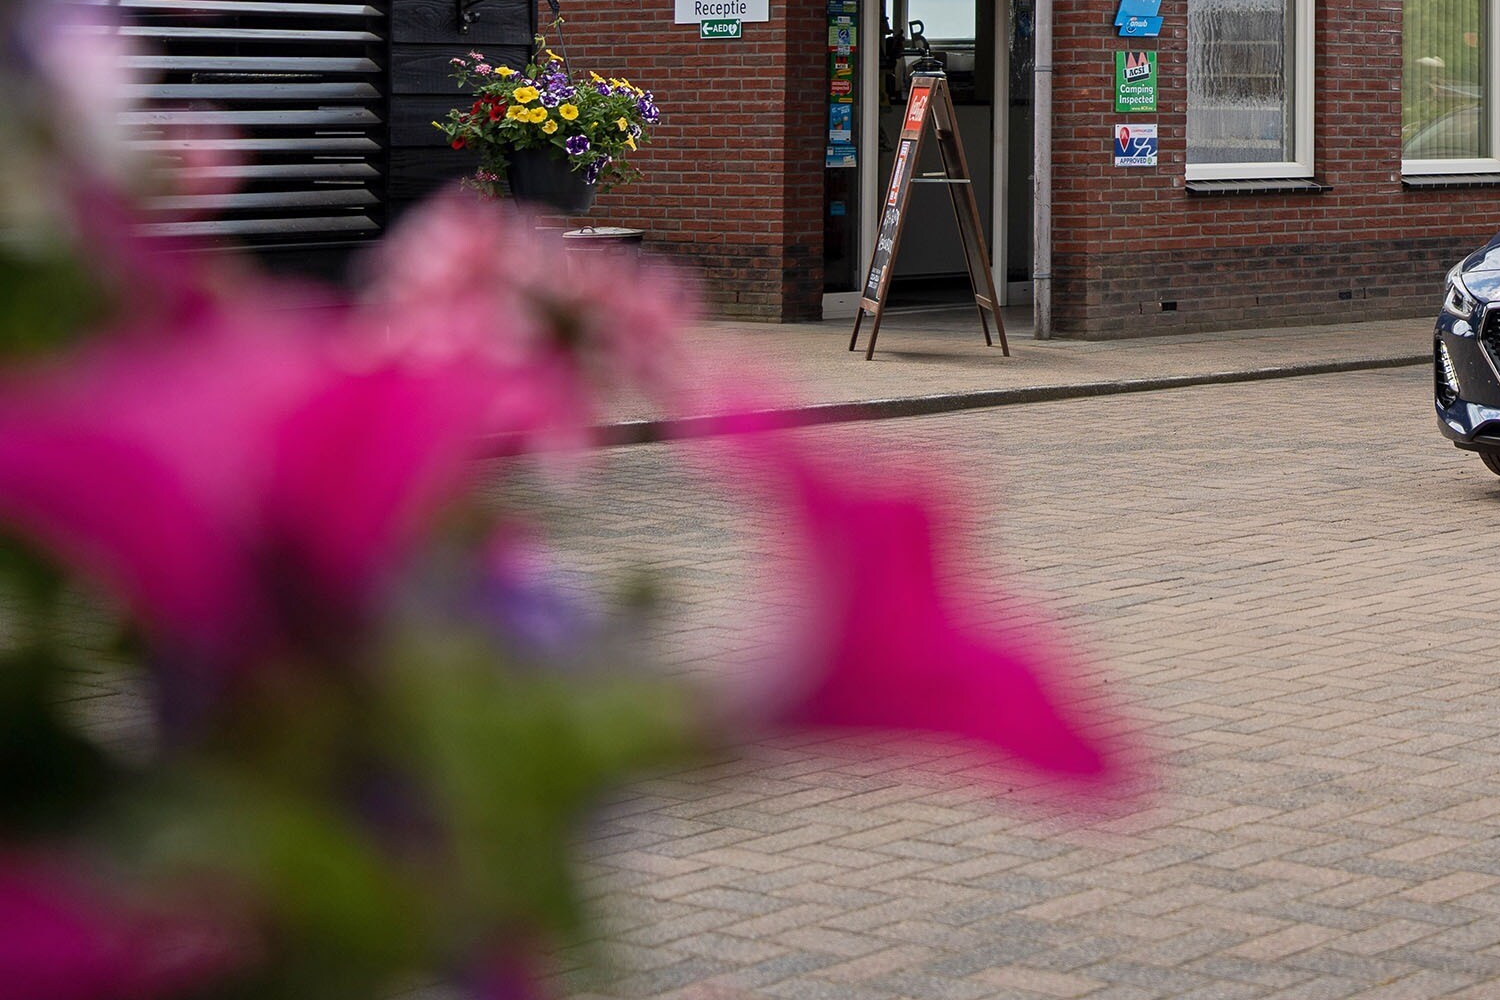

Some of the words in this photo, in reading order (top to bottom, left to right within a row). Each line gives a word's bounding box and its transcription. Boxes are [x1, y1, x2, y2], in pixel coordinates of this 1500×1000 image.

[694, 0, 747, 18] Receptie
[712, 23, 728, 33] AED
[1120, 83, 1154, 95] Camping
[1119, 94, 1154, 105] Inspected
